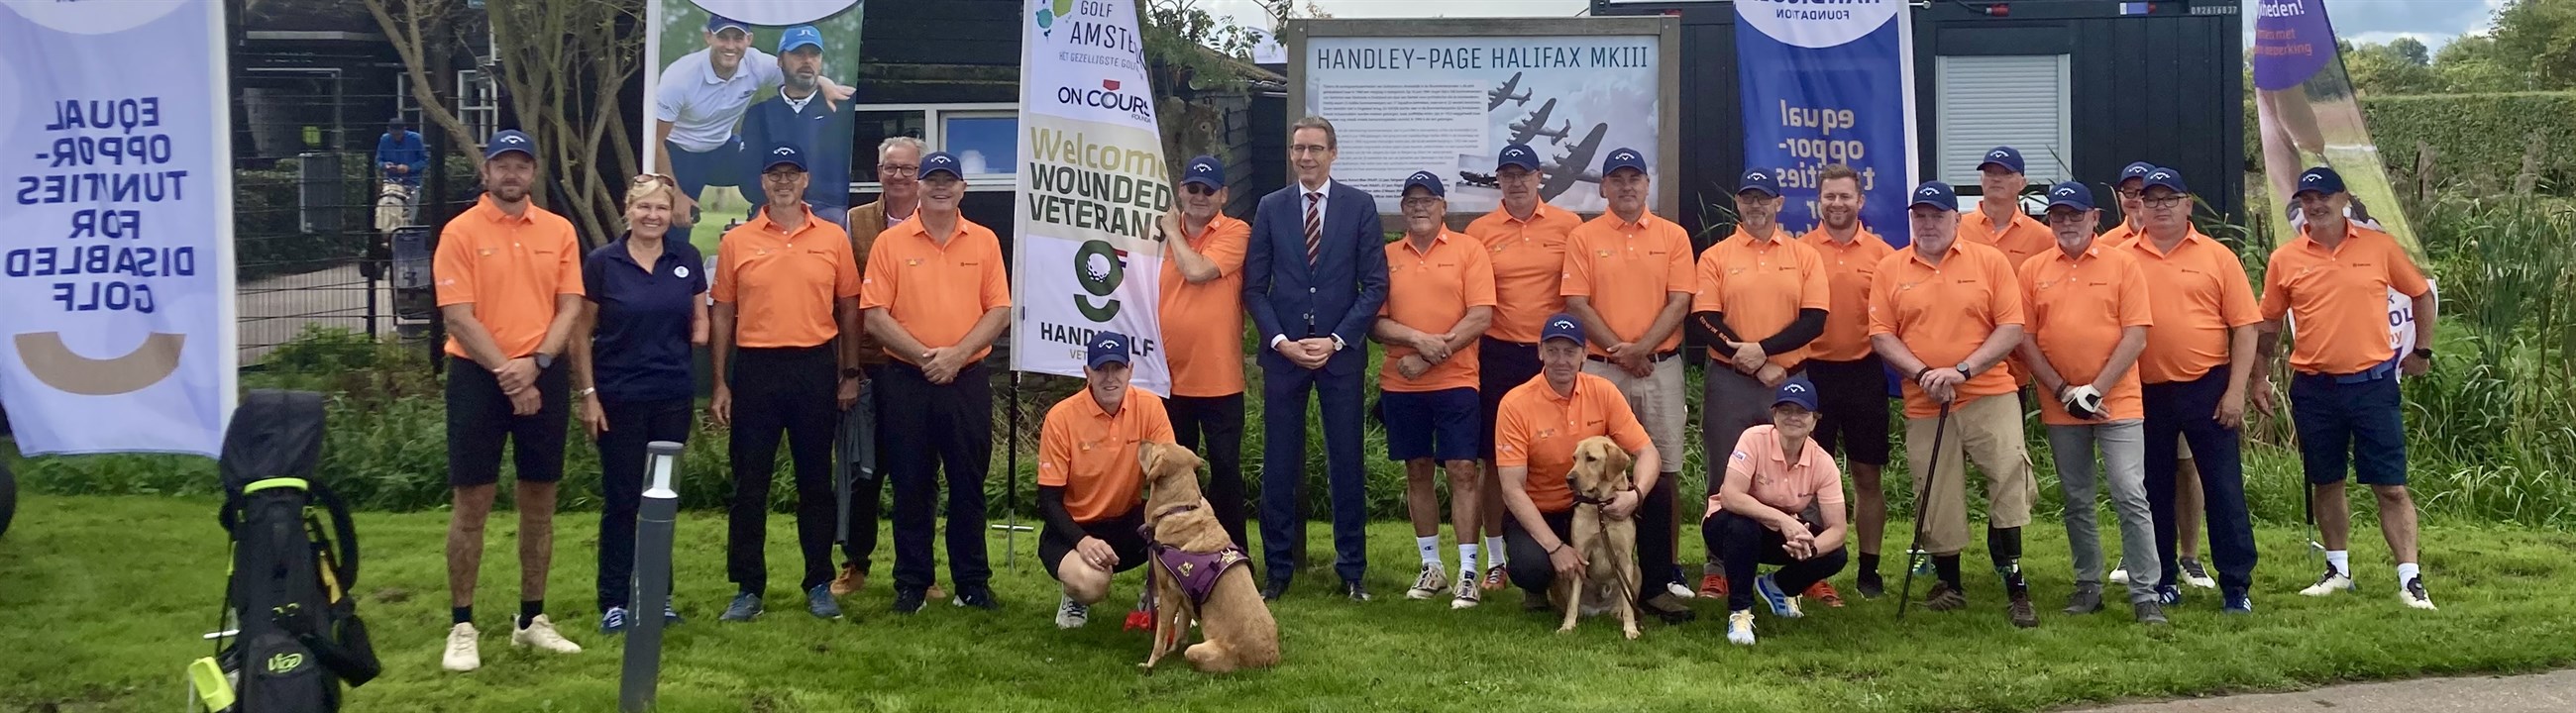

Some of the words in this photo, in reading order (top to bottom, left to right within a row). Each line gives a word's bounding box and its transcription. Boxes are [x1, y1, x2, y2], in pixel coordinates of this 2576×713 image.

[1080, 0, 1114, 18] GOLF
[1059, 51, 1069, 61] HET
[1070, 52, 1119, 67] GEZELLIGSTE
[1317, 48, 1482, 69] HANDLEY-PAGE
[1492, 47, 1581, 68] HALIFAX
[1590, 47, 1648, 68] MKIII
[1057, 86, 1082, 105] ON
[1029, 161, 1173, 213] WOUNDED
[1028, 192, 1167, 243] VETERANS
[1040, 321, 1154, 357] HANDLF
